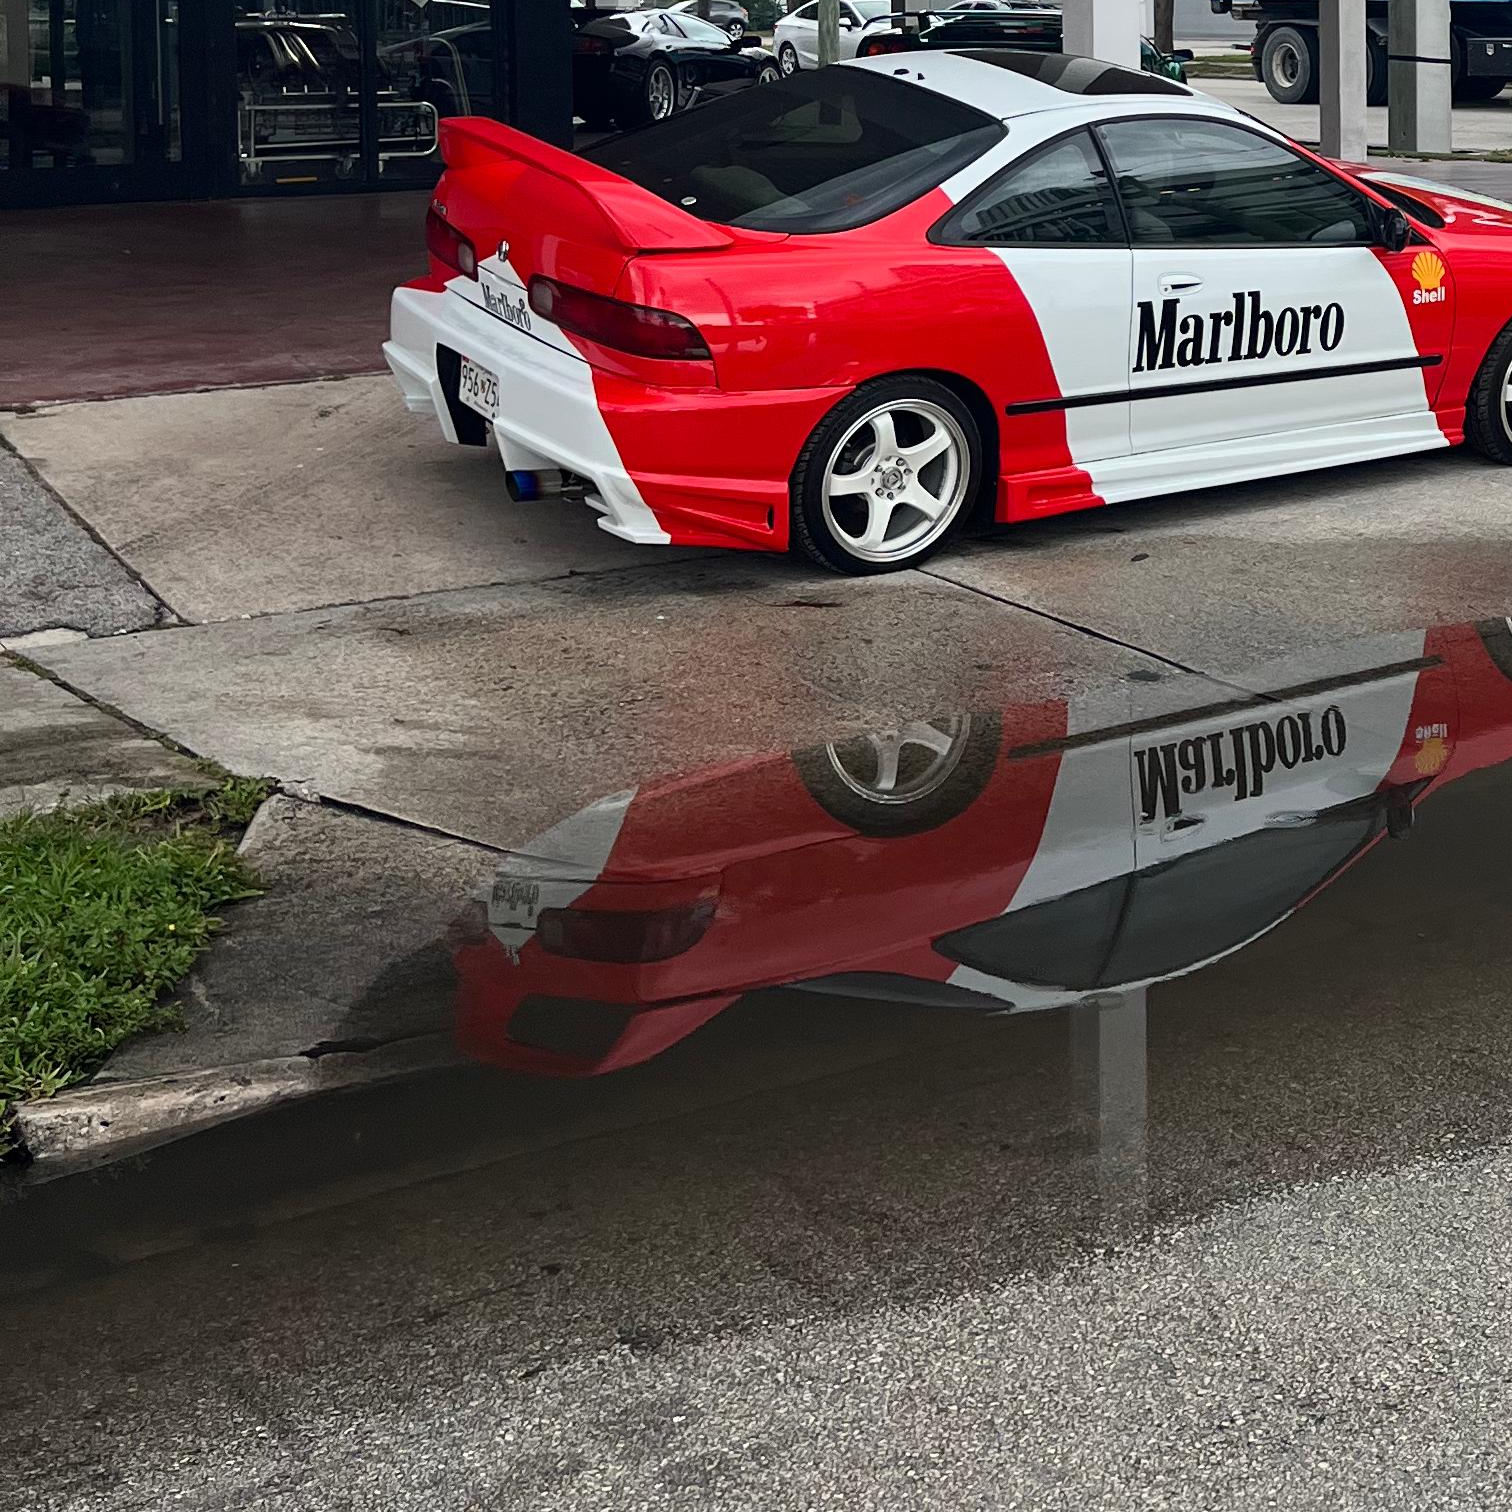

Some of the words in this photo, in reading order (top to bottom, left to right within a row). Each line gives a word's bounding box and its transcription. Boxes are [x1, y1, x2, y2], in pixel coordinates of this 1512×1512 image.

[481, 282, 532, 331] Marlboro
[1413, 286, 1446, 305] Shell
[1132, 291, 1345, 373] Marlboro
